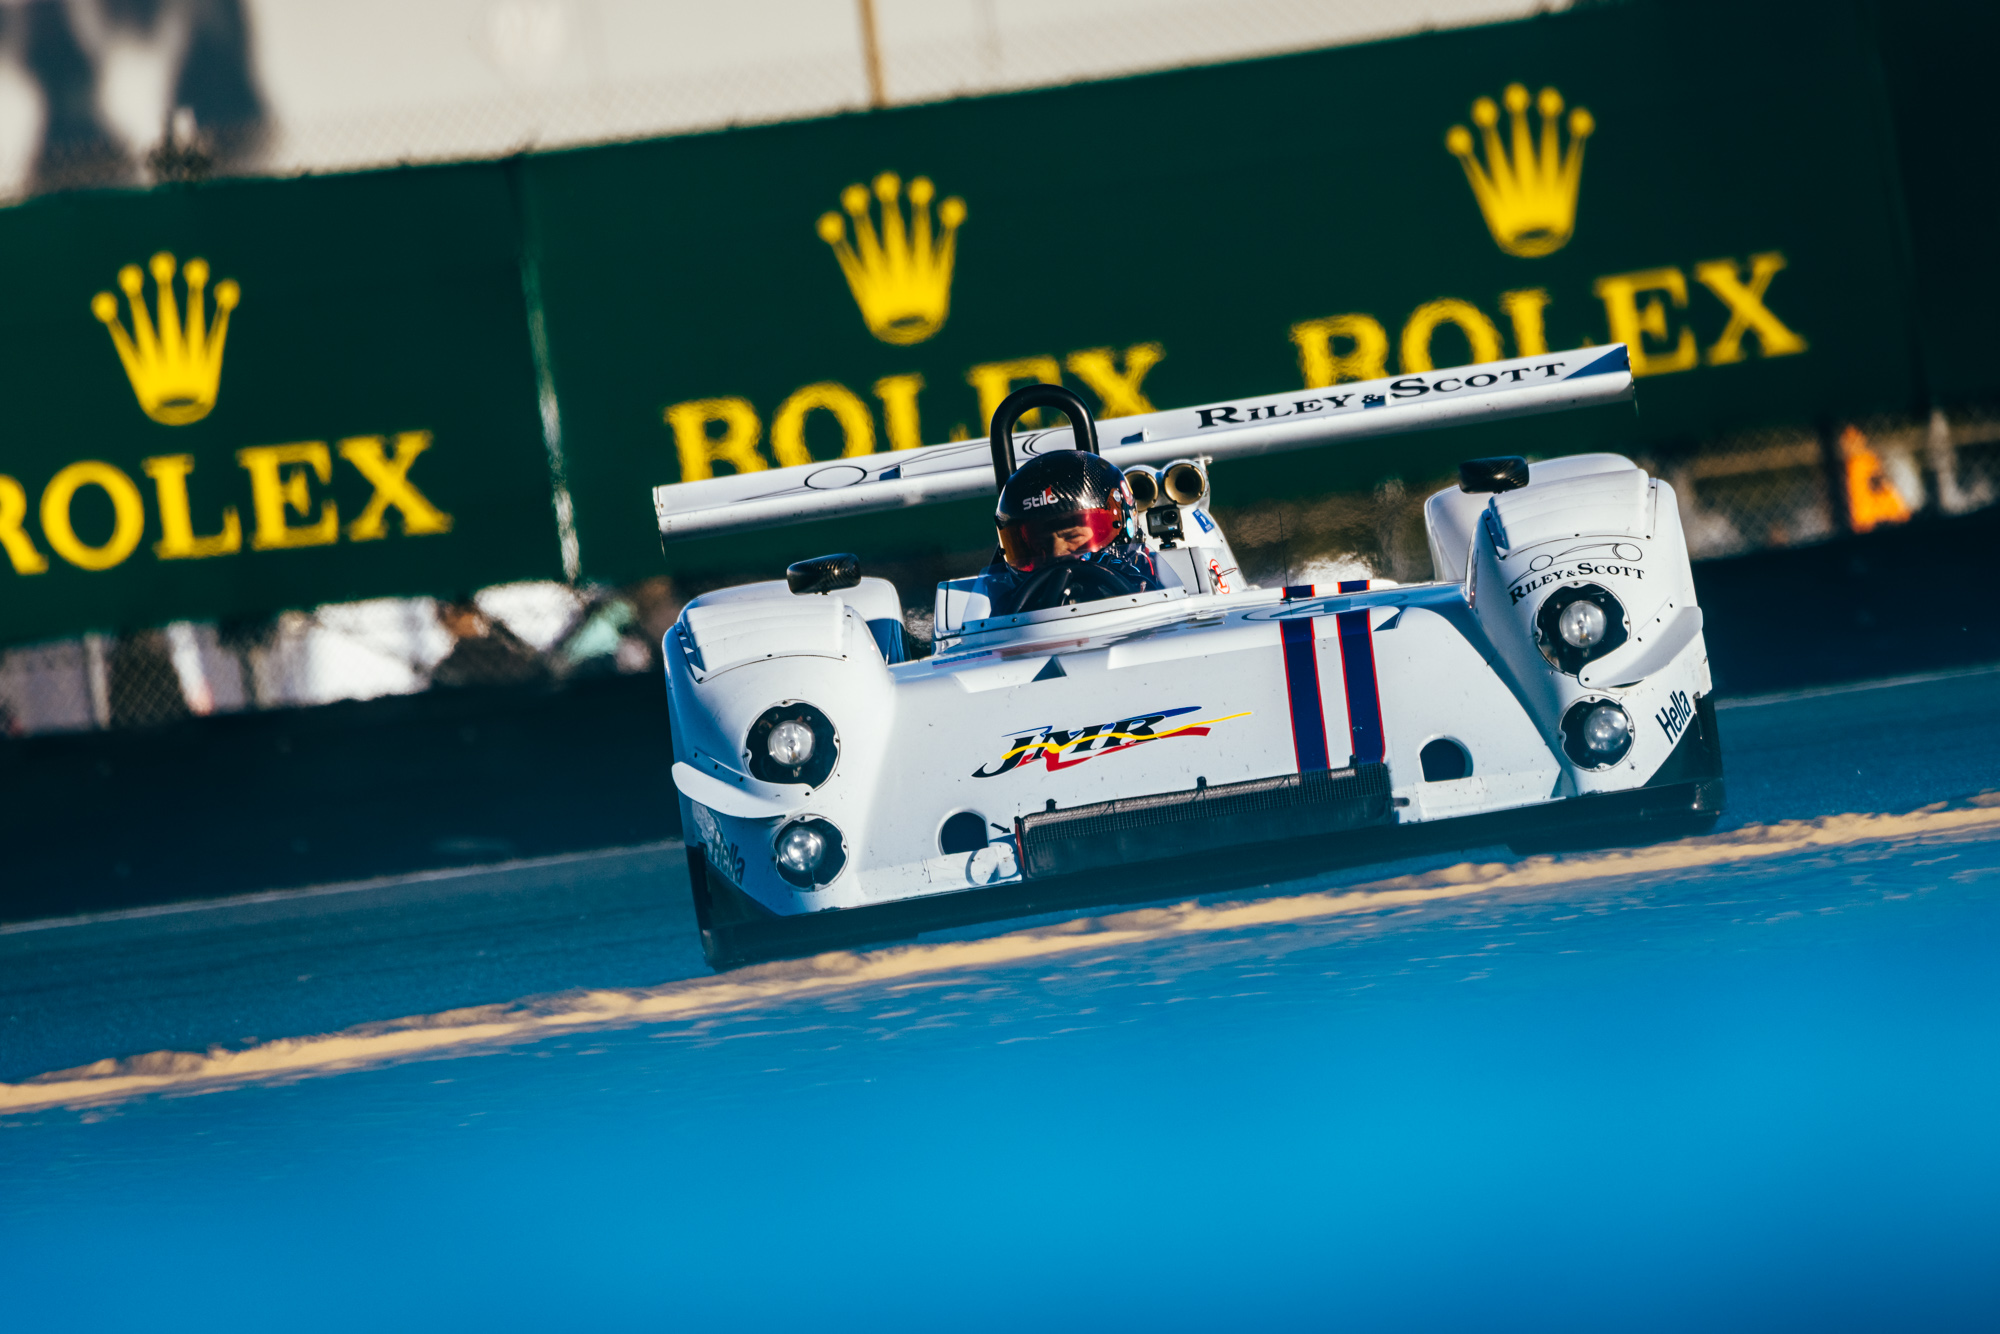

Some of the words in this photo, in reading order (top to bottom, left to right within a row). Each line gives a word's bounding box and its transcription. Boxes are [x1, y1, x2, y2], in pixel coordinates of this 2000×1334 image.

[1289, 252, 1808, 389] ROLEX
[1195, 392, 1355, 429] RILEY
[1390, 362, 1565, 399] SCOTT
[1508, 569, 1564, 606] RILEY
[1577, 562, 1645, 580] SCOTT
[971, 715, 1166, 778] JMR
[1655, 690, 1692, 745] Hella
